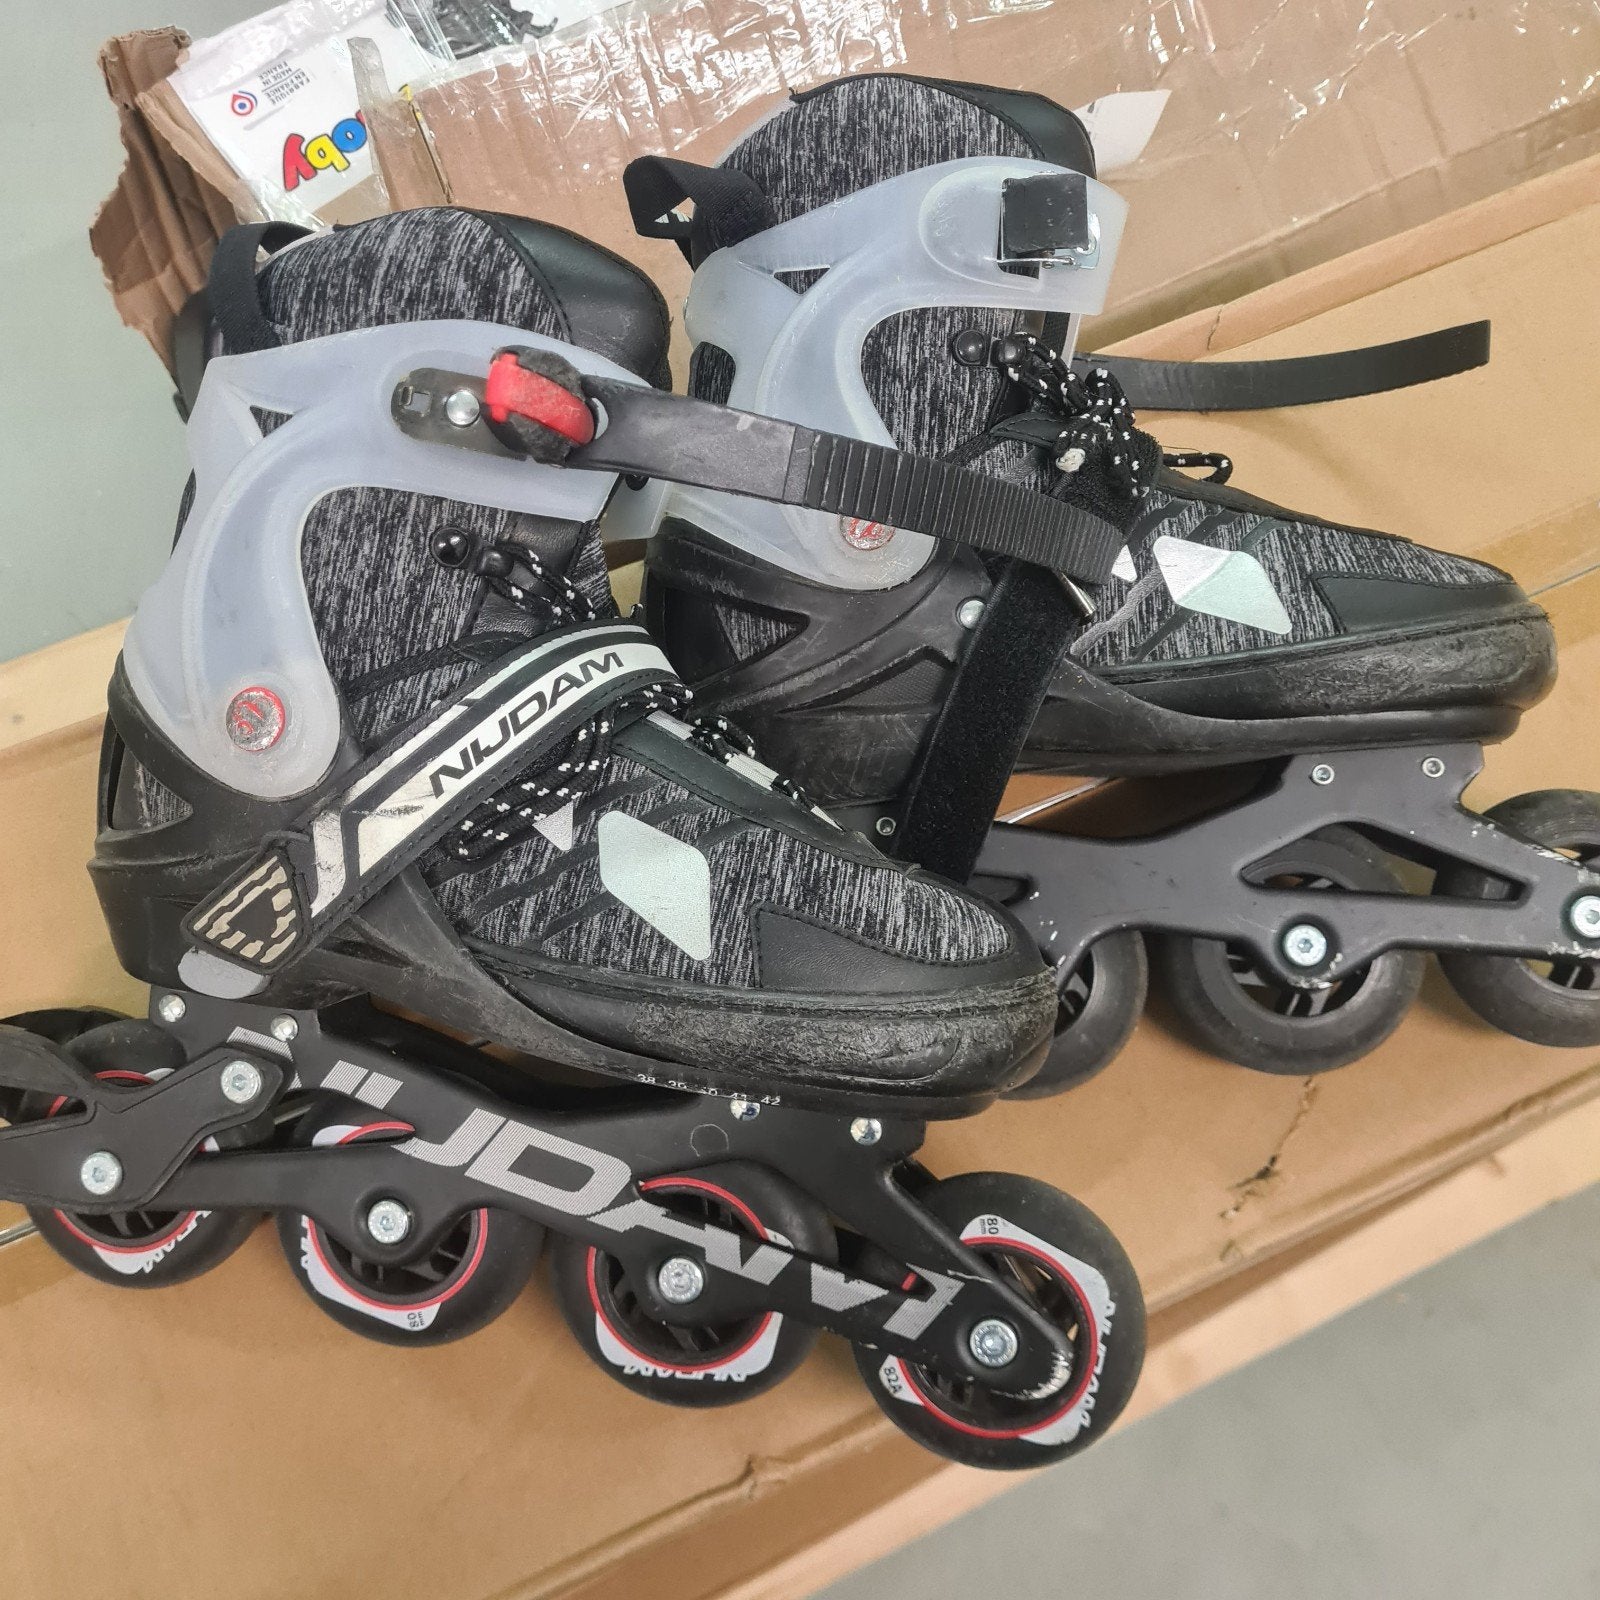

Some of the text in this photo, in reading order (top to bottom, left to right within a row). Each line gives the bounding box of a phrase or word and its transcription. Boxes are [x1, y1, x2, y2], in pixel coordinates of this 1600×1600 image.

[257, 61, 288, 80] FRANCE
[262, 67, 292, 87] MADE IN
[264, 78, 295, 98] FRANCE
[283, 110, 368, 192] oby
[428, 650, 625, 799] NIJDAM
[636, 1073, 656, 1085] 38
[760, 1094, 782, 1106] 42
[986, 1217, 999, 1235] 80
[884, 1366, 903, 1394] 82A
